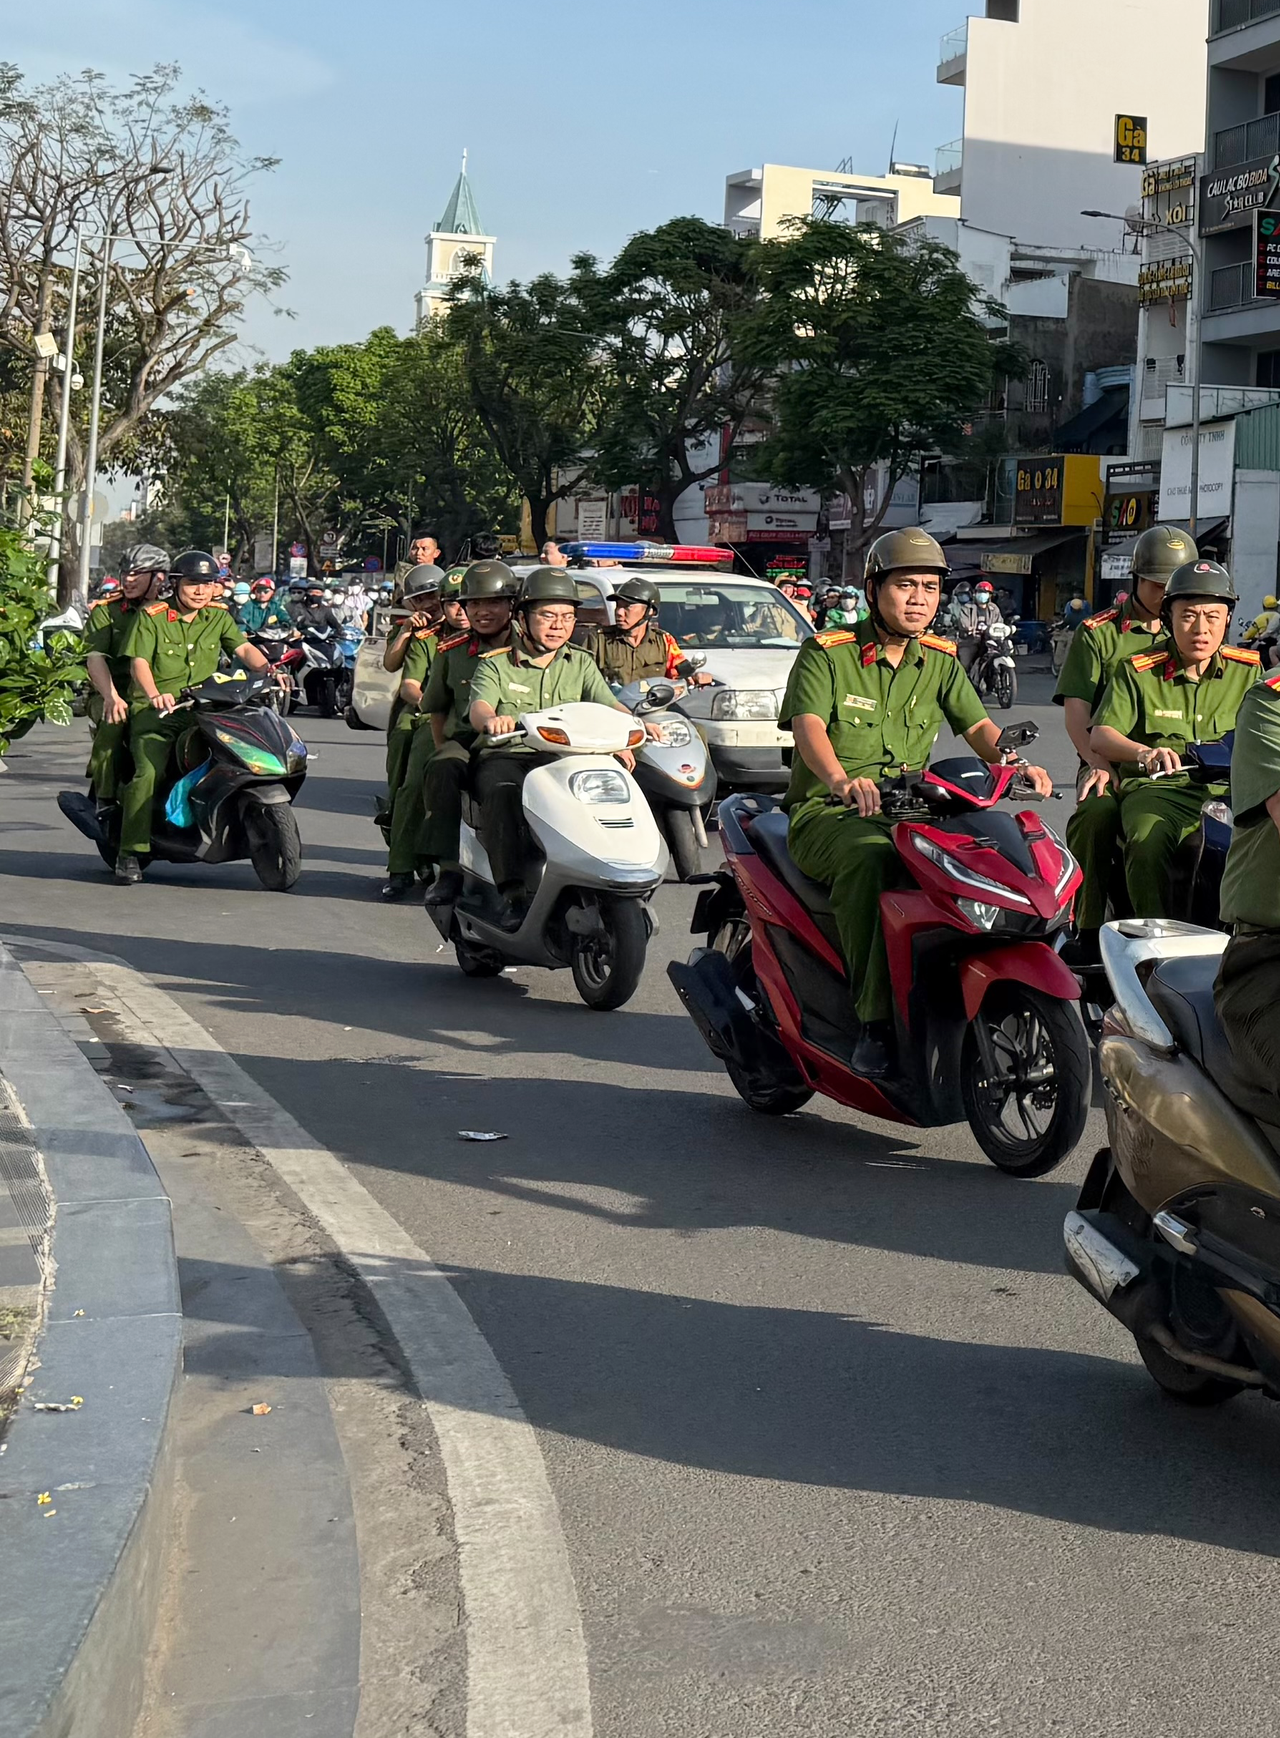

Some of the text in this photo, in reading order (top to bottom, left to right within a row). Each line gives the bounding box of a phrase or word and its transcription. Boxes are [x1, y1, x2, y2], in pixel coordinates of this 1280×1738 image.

[1118, 117, 1145, 147] Gà
[1122, 148, 1140, 161] 34
[1245, 191, 1264, 207] CLUB
[1017, 469, 1031, 491] Gà
[1045, 468, 1058, 490] 34
[774, 494, 808, 503] TOTAL
[1111, 498, 1137, 526] SAO
